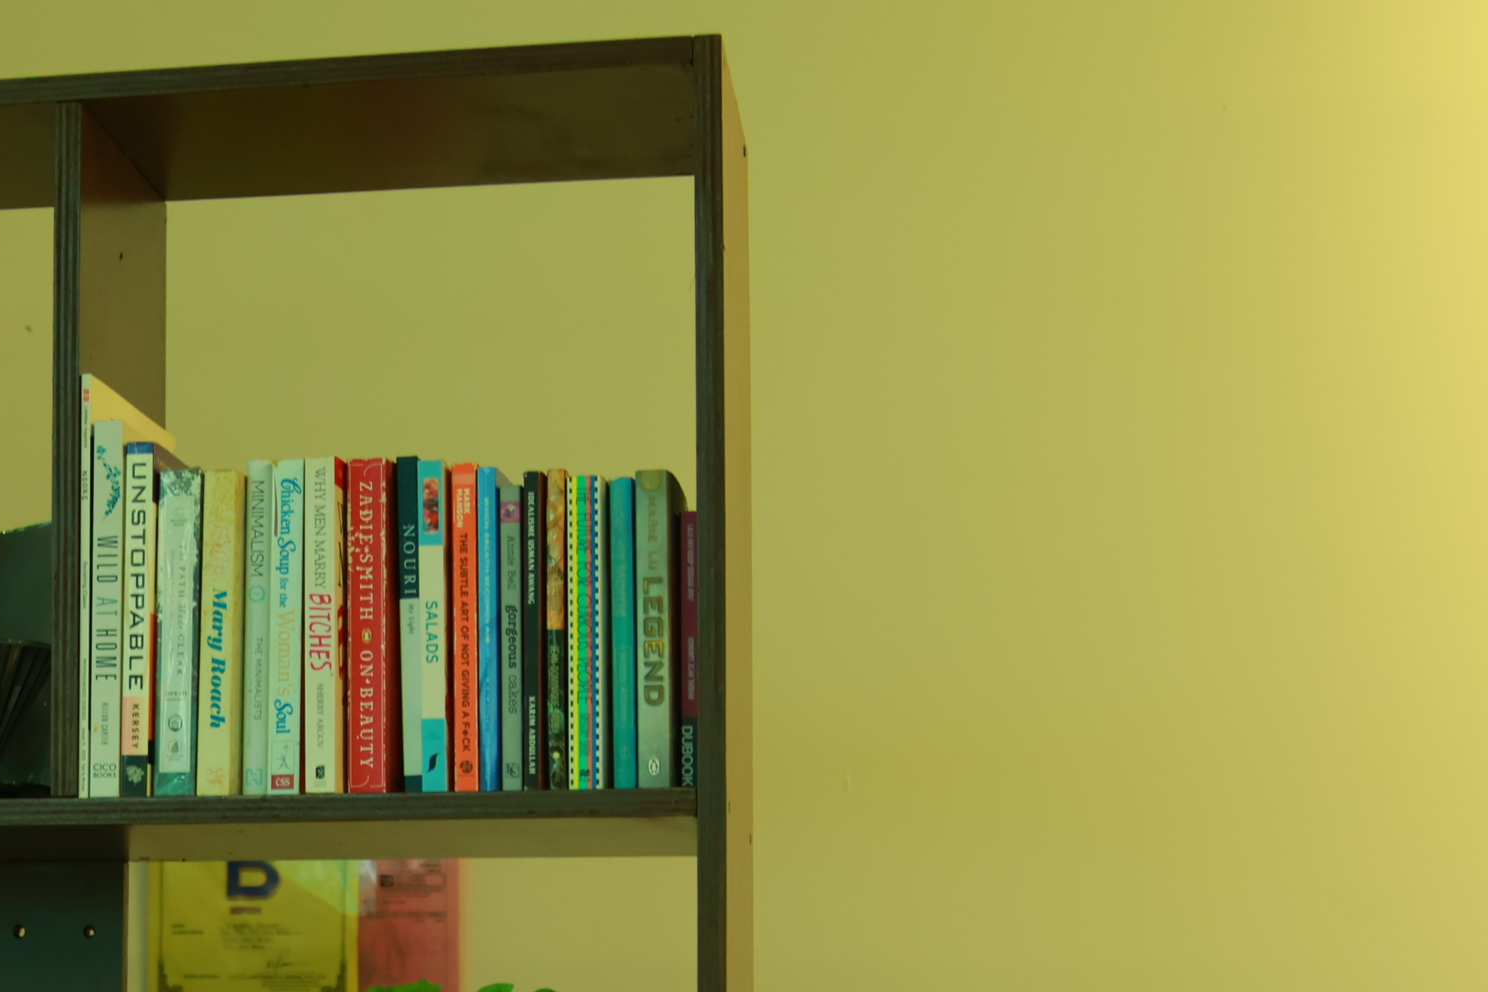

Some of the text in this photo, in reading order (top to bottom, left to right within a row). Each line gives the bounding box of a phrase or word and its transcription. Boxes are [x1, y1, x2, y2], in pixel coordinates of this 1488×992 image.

[250, 480, 266, 577] MINIMALISM
[455, 488, 463, 528] MANSON
[576, 512, 592, 554] FUTURE
[309, 466, 333, 672] WHY MEN MARRY BITCHES
[402, 524, 417, 596] NOURI
[459, 533, 468, 556] THE
[506, 534, 516, 590] Annie Bell
[527, 491, 535, 605] IDEALISME USMAN AWANG
[127, 462, 148, 692] UNSTOPPABLE
[176, 565, 187, 598] PATH
[359, 552, 375, 621] SMITH
[459, 556, 468, 598] SUBTLE
[577, 561, 592, 586] FOR
[95, 535, 119, 682] WILD AT HOME
[274, 477, 302, 734] Chicken Soup for the Woman's Soul
[425, 601, 439, 665] SALADS
[460, 599, 469, 623] ART
[460, 624, 469, 641] OF
[175, 633, 185, 676] CLEAR
[207, 587, 228, 729] Mary Roach
[460, 642, 470, 668] NOT
[505, 604, 519, 715] gorgeous cakes
[642, 576, 664, 706] LEGEND
[253, 637, 263, 721] THE MINIMALISTS
[461, 669, 470, 709] GIVING
[577, 657, 593, 704] PEOPLE
[130, 703, 141, 750] KERSEY
[358, 687, 375, 769] BEAUTY
[461, 710, 470, 719] A
[528, 696, 536, 775] KARIM ABDULLAH
[92, 763, 117, 772] CICO
[92, 771, 117, 780] BOOKS
[681, 724, 693, 786] DUBOOK
